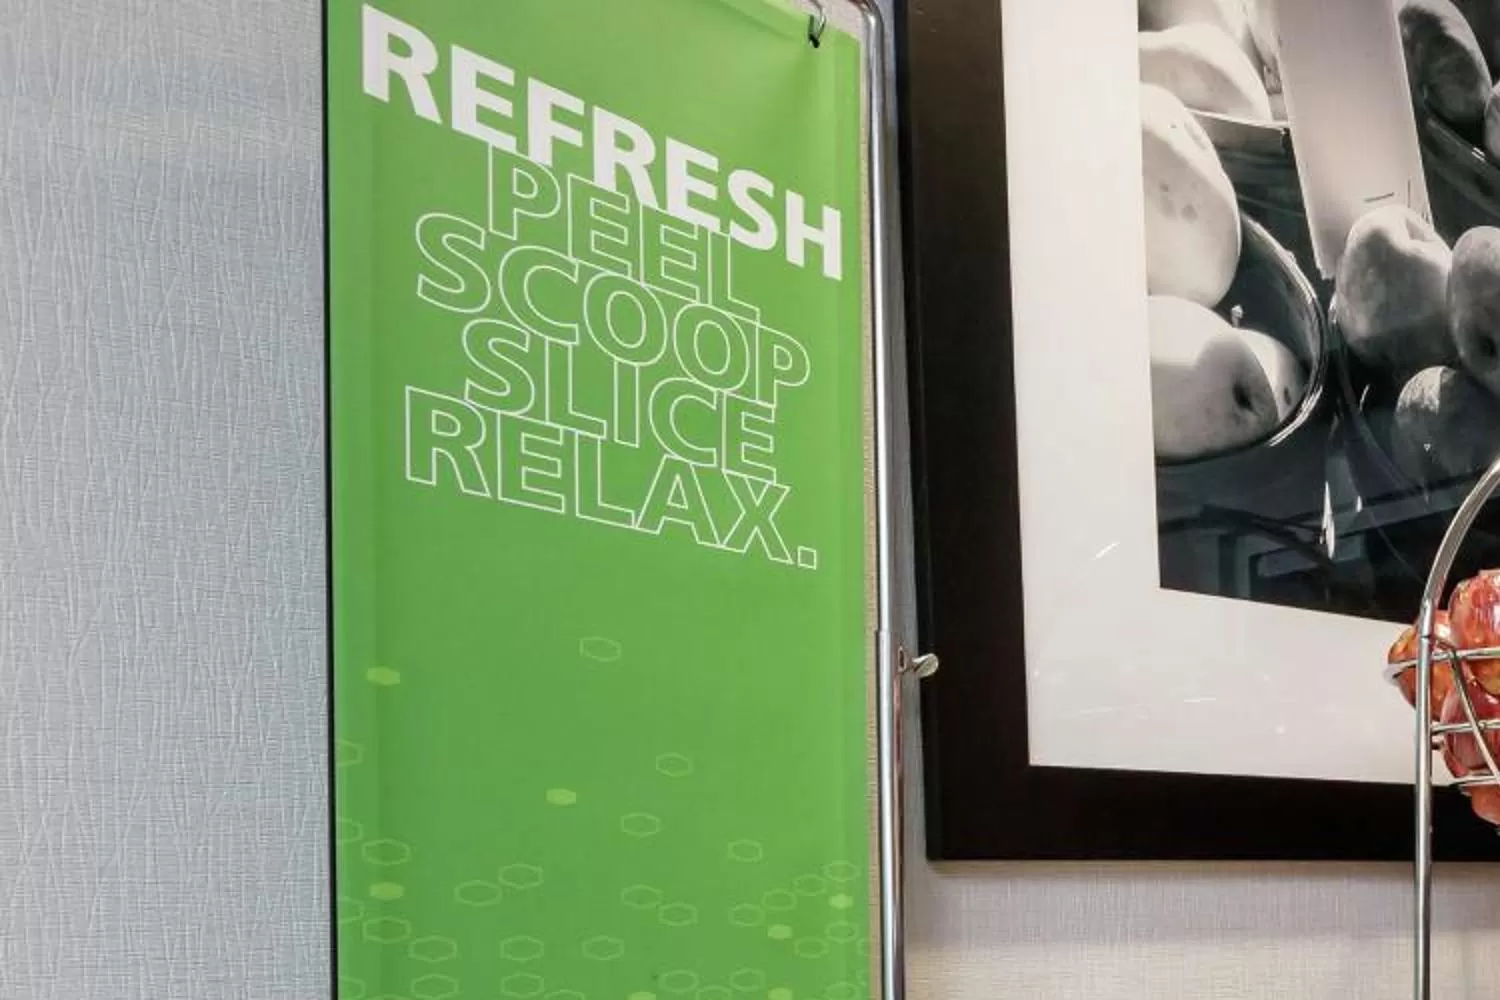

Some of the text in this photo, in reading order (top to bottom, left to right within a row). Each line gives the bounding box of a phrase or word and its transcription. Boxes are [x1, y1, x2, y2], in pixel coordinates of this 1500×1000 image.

[362, 4, 842, 280] REFRESH
[488, 143, 760, 321] PEEL
[415, 213, 810, 407] SCOOP
[462, 319, 777, 482] SLICE
[405, 385, 817, 569] RELAX.
